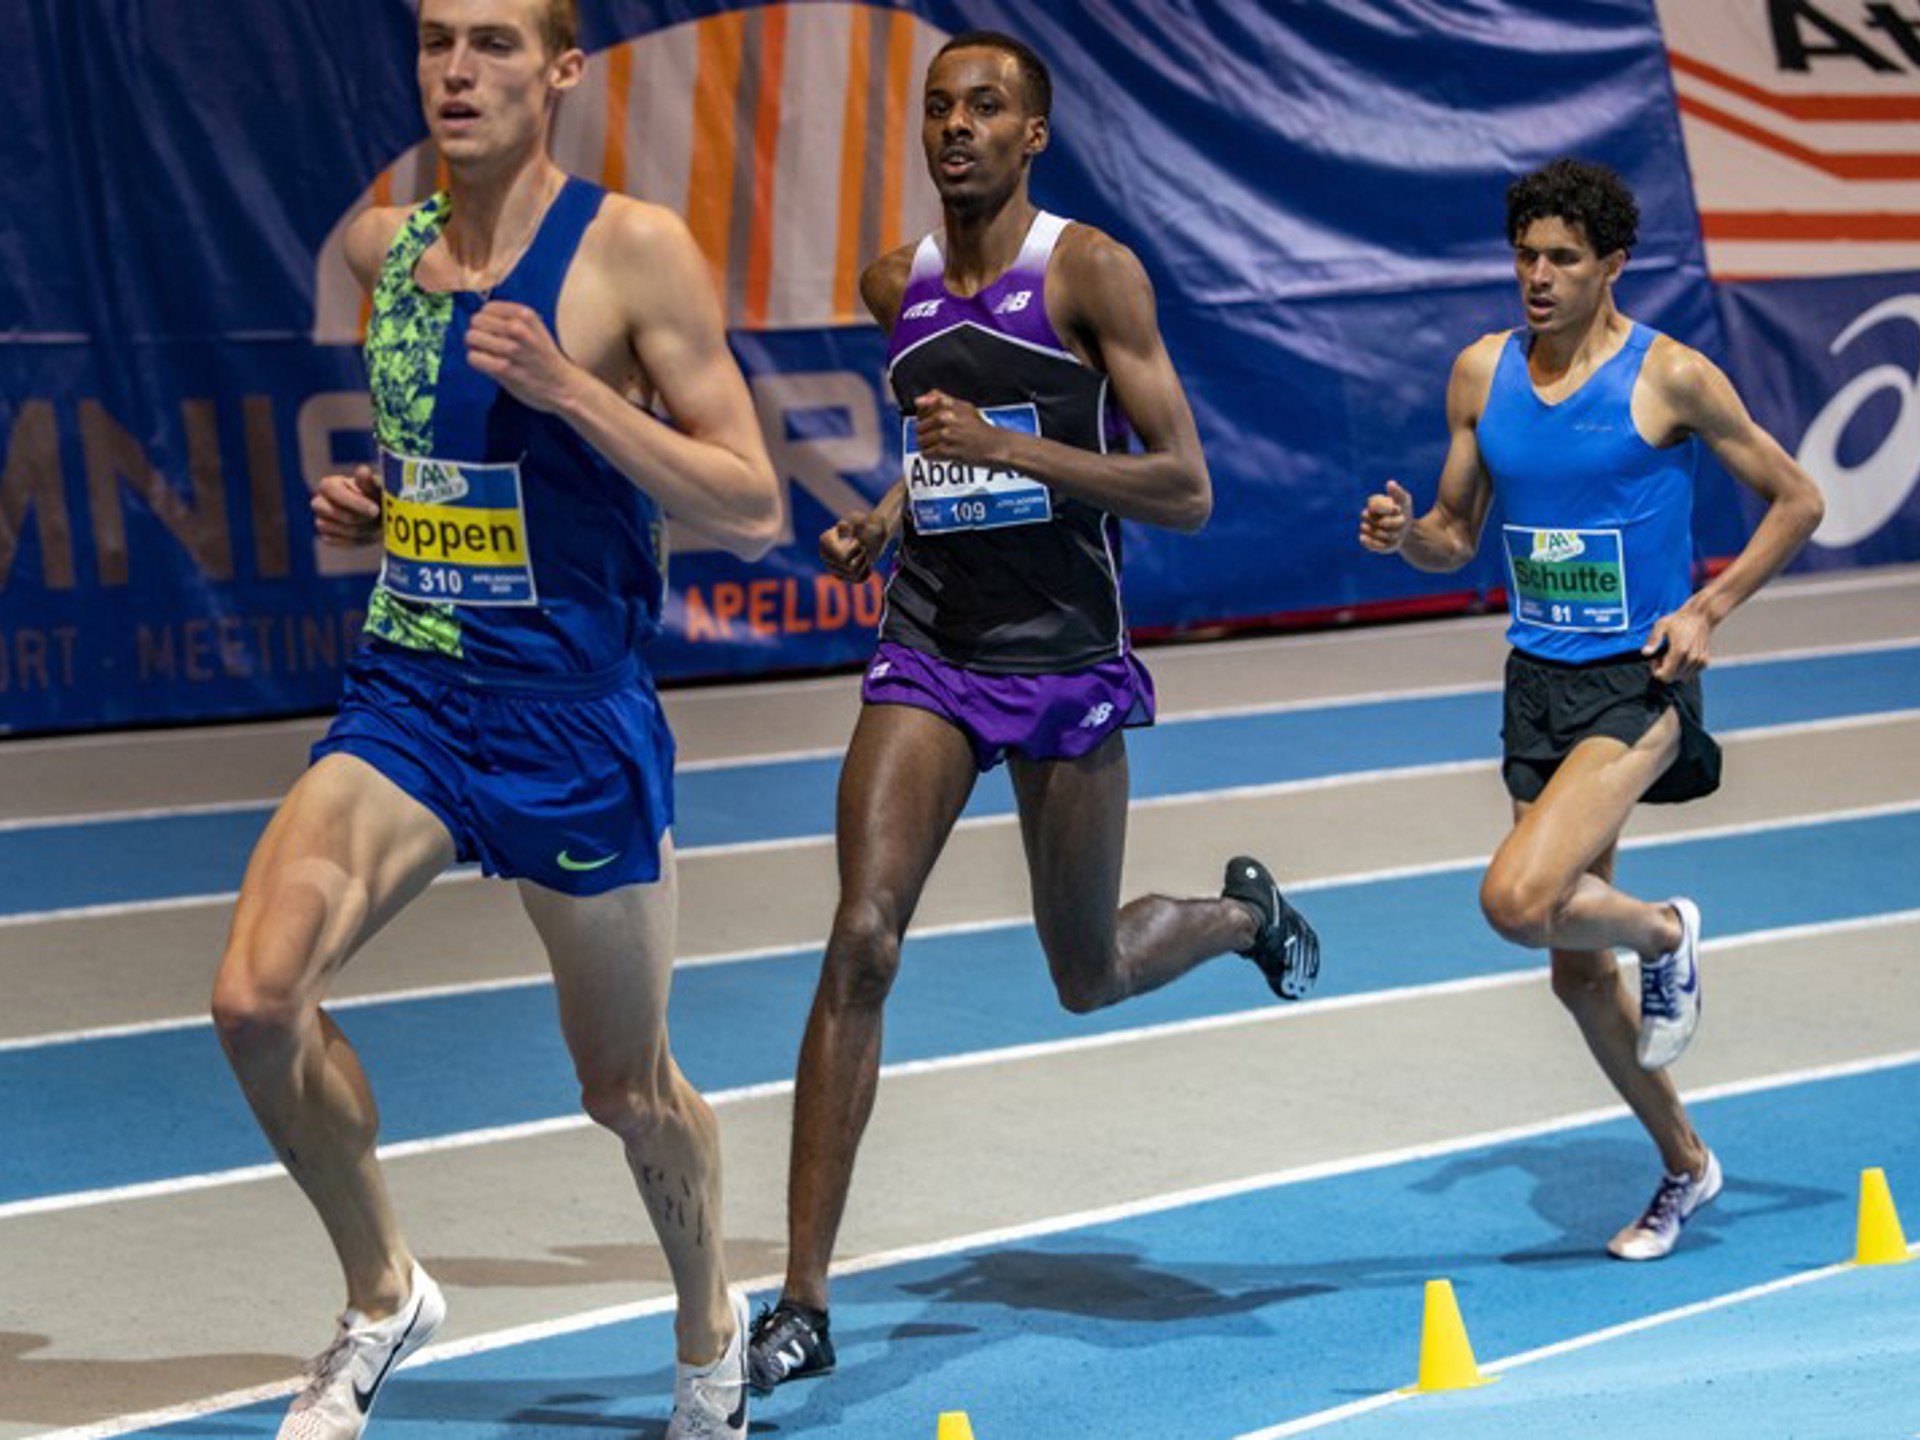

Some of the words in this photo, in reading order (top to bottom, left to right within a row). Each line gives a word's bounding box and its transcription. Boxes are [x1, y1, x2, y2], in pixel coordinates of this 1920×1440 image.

[951, 501, 986, 522] 109
[418, 568, 462, 593] 310
[1514, 560, 1618, 593] Schutte
